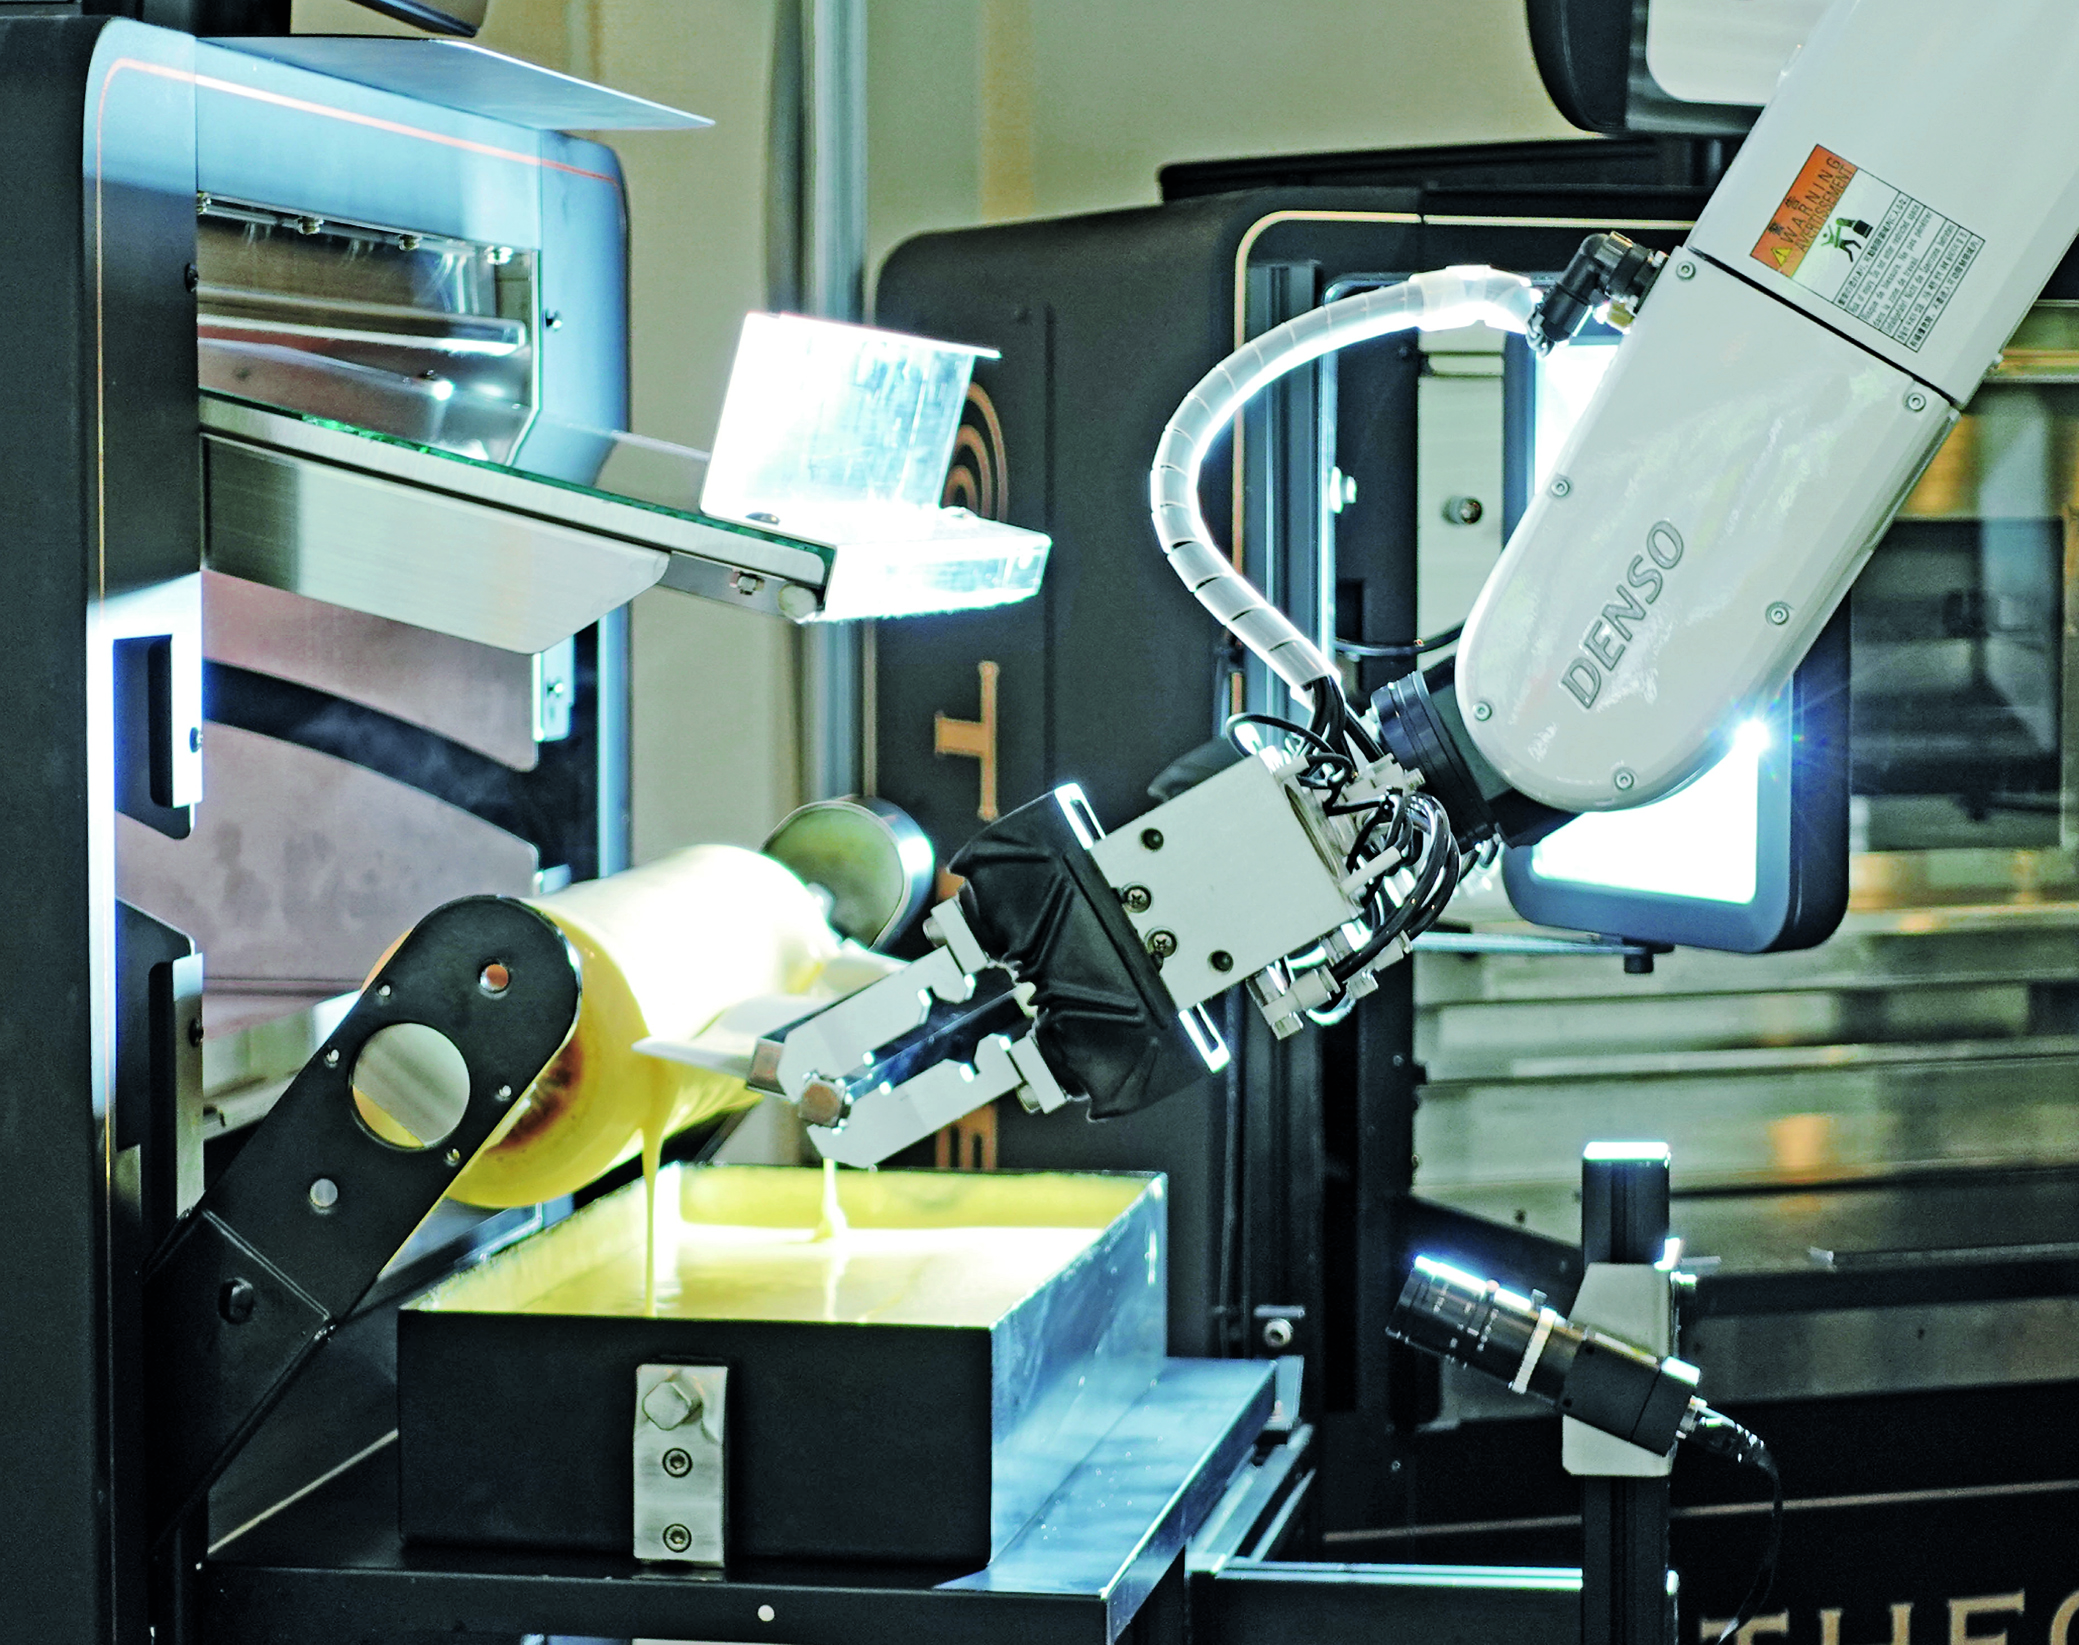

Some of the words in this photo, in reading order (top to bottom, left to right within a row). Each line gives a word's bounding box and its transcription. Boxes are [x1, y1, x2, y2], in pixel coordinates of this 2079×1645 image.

[1780, 156, 1840, 244] WARNING
[1793, 164, 1854, 253] AVERTISSEMENT
[1561, 520, 1684, 709] DENSO
